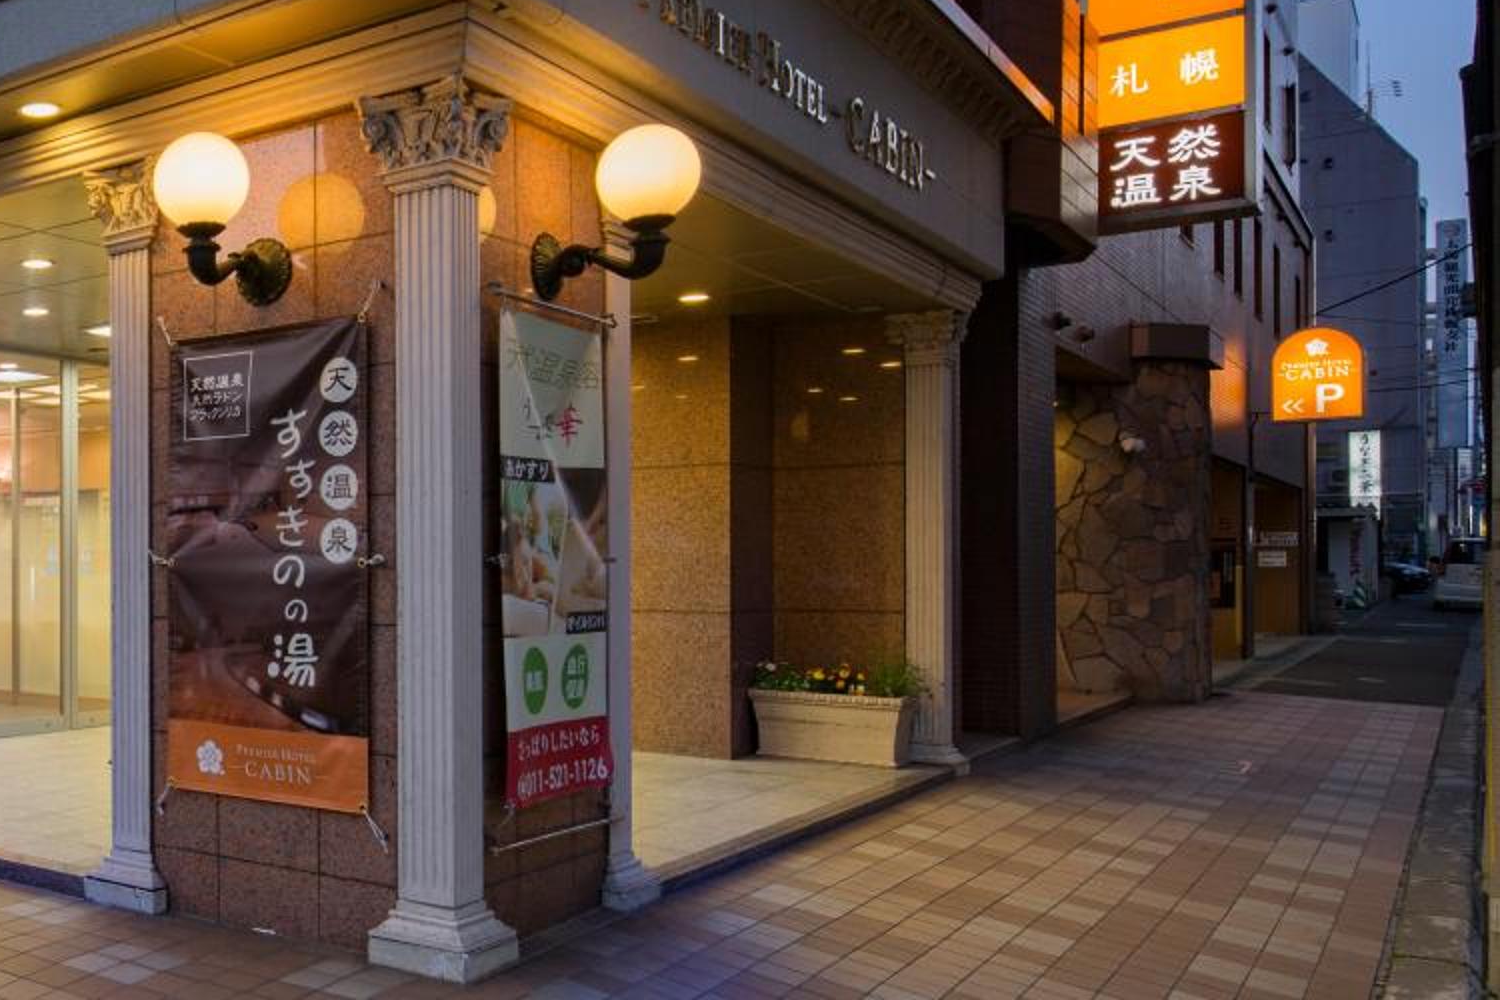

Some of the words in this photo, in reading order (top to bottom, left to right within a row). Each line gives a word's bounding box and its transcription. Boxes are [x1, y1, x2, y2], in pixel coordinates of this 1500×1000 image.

[756, 30, 827, 125] HOTEL
[1109, 48, 1220, 99] 札幌
[846, 96, 924, 192] CABIN
[1110, 124, 1221, 170] 天然
[1110, 163, 1221, 209] 温泉
[1285, 366, 1349, 381] CABIN
[1315, 383, 1345, 413] P
[322, 361, 356, 558] 天然温泉
[244, 761, 313, 785] CABIN
